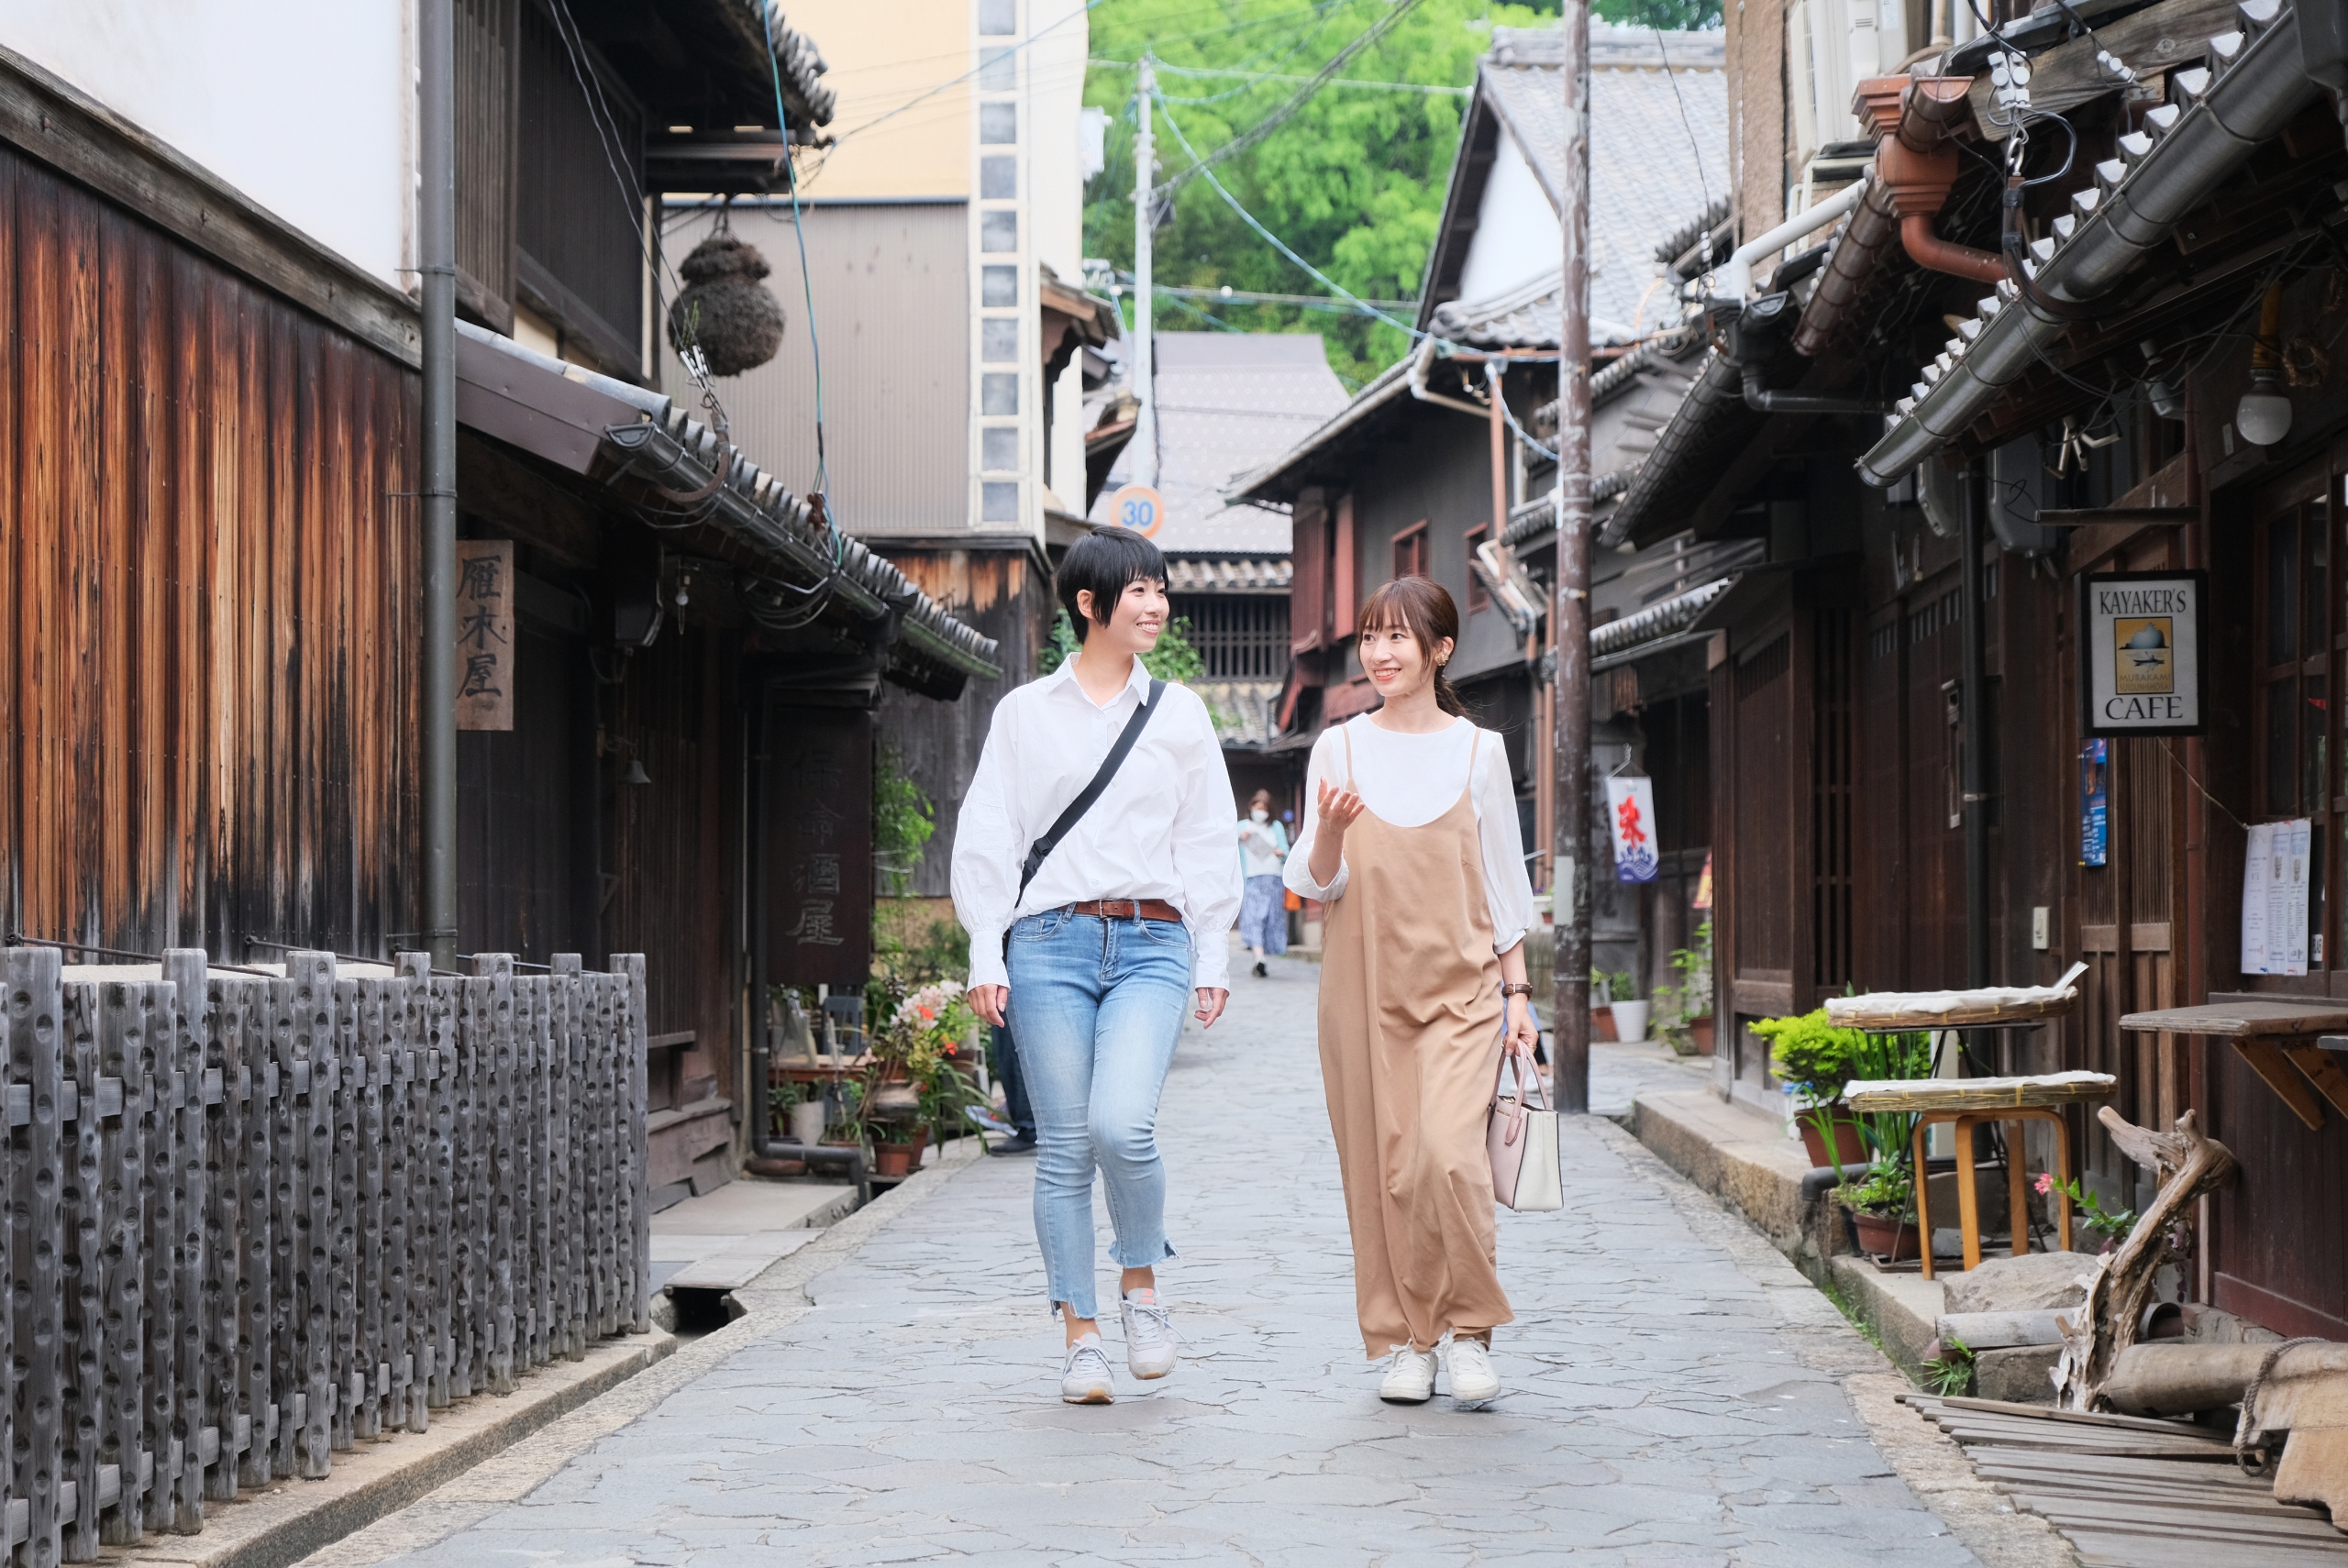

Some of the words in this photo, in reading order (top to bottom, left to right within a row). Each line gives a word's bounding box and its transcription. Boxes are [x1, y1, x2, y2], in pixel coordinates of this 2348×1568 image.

[1122, 500, 1154, 527] 30
[2099, 588, 2187, 614] KAYAKER'S
[456, 555, 508, 700] 雁木屋
[2119, 673, 2171, 682] MURAKAMI
[2105, 696, 2184, 721] CAFE
[1617, 795, 1647, 851] 氷
[784, 749, 845, 946] 保命酒屋
